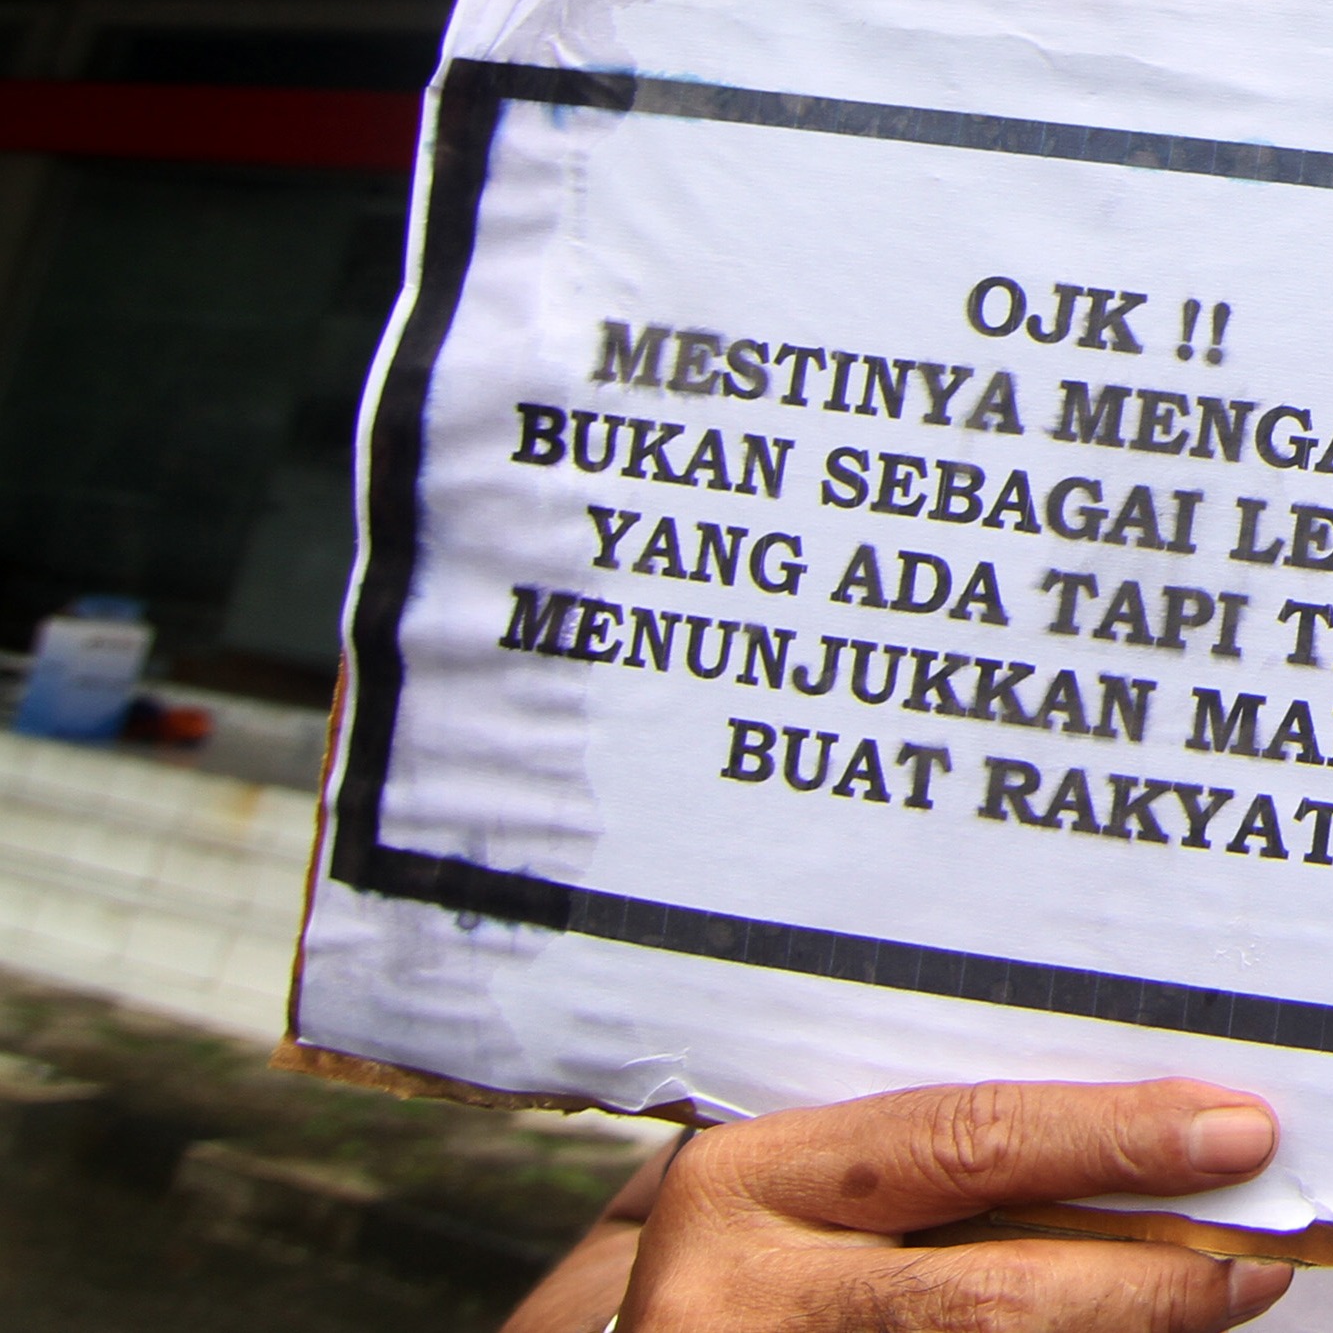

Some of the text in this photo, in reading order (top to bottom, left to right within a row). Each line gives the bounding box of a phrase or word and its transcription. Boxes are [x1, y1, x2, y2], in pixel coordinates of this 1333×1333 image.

[592, 321, 1025, 436] MESTINYA
[967, 276, 1232, 366] OJK !!
[511, 401, 796, 500] BUKAN
[821, 446, 1204, 555] SEBAGAI
[586, 504, 809, 597] YANG
[830, 544, 1010, 627] ADA
[1041, 568, 1250, 659] TAPI
[498, 584, 1158, 743] MENUNJUKKAN
[720, 717, 953, 811] BUAT
